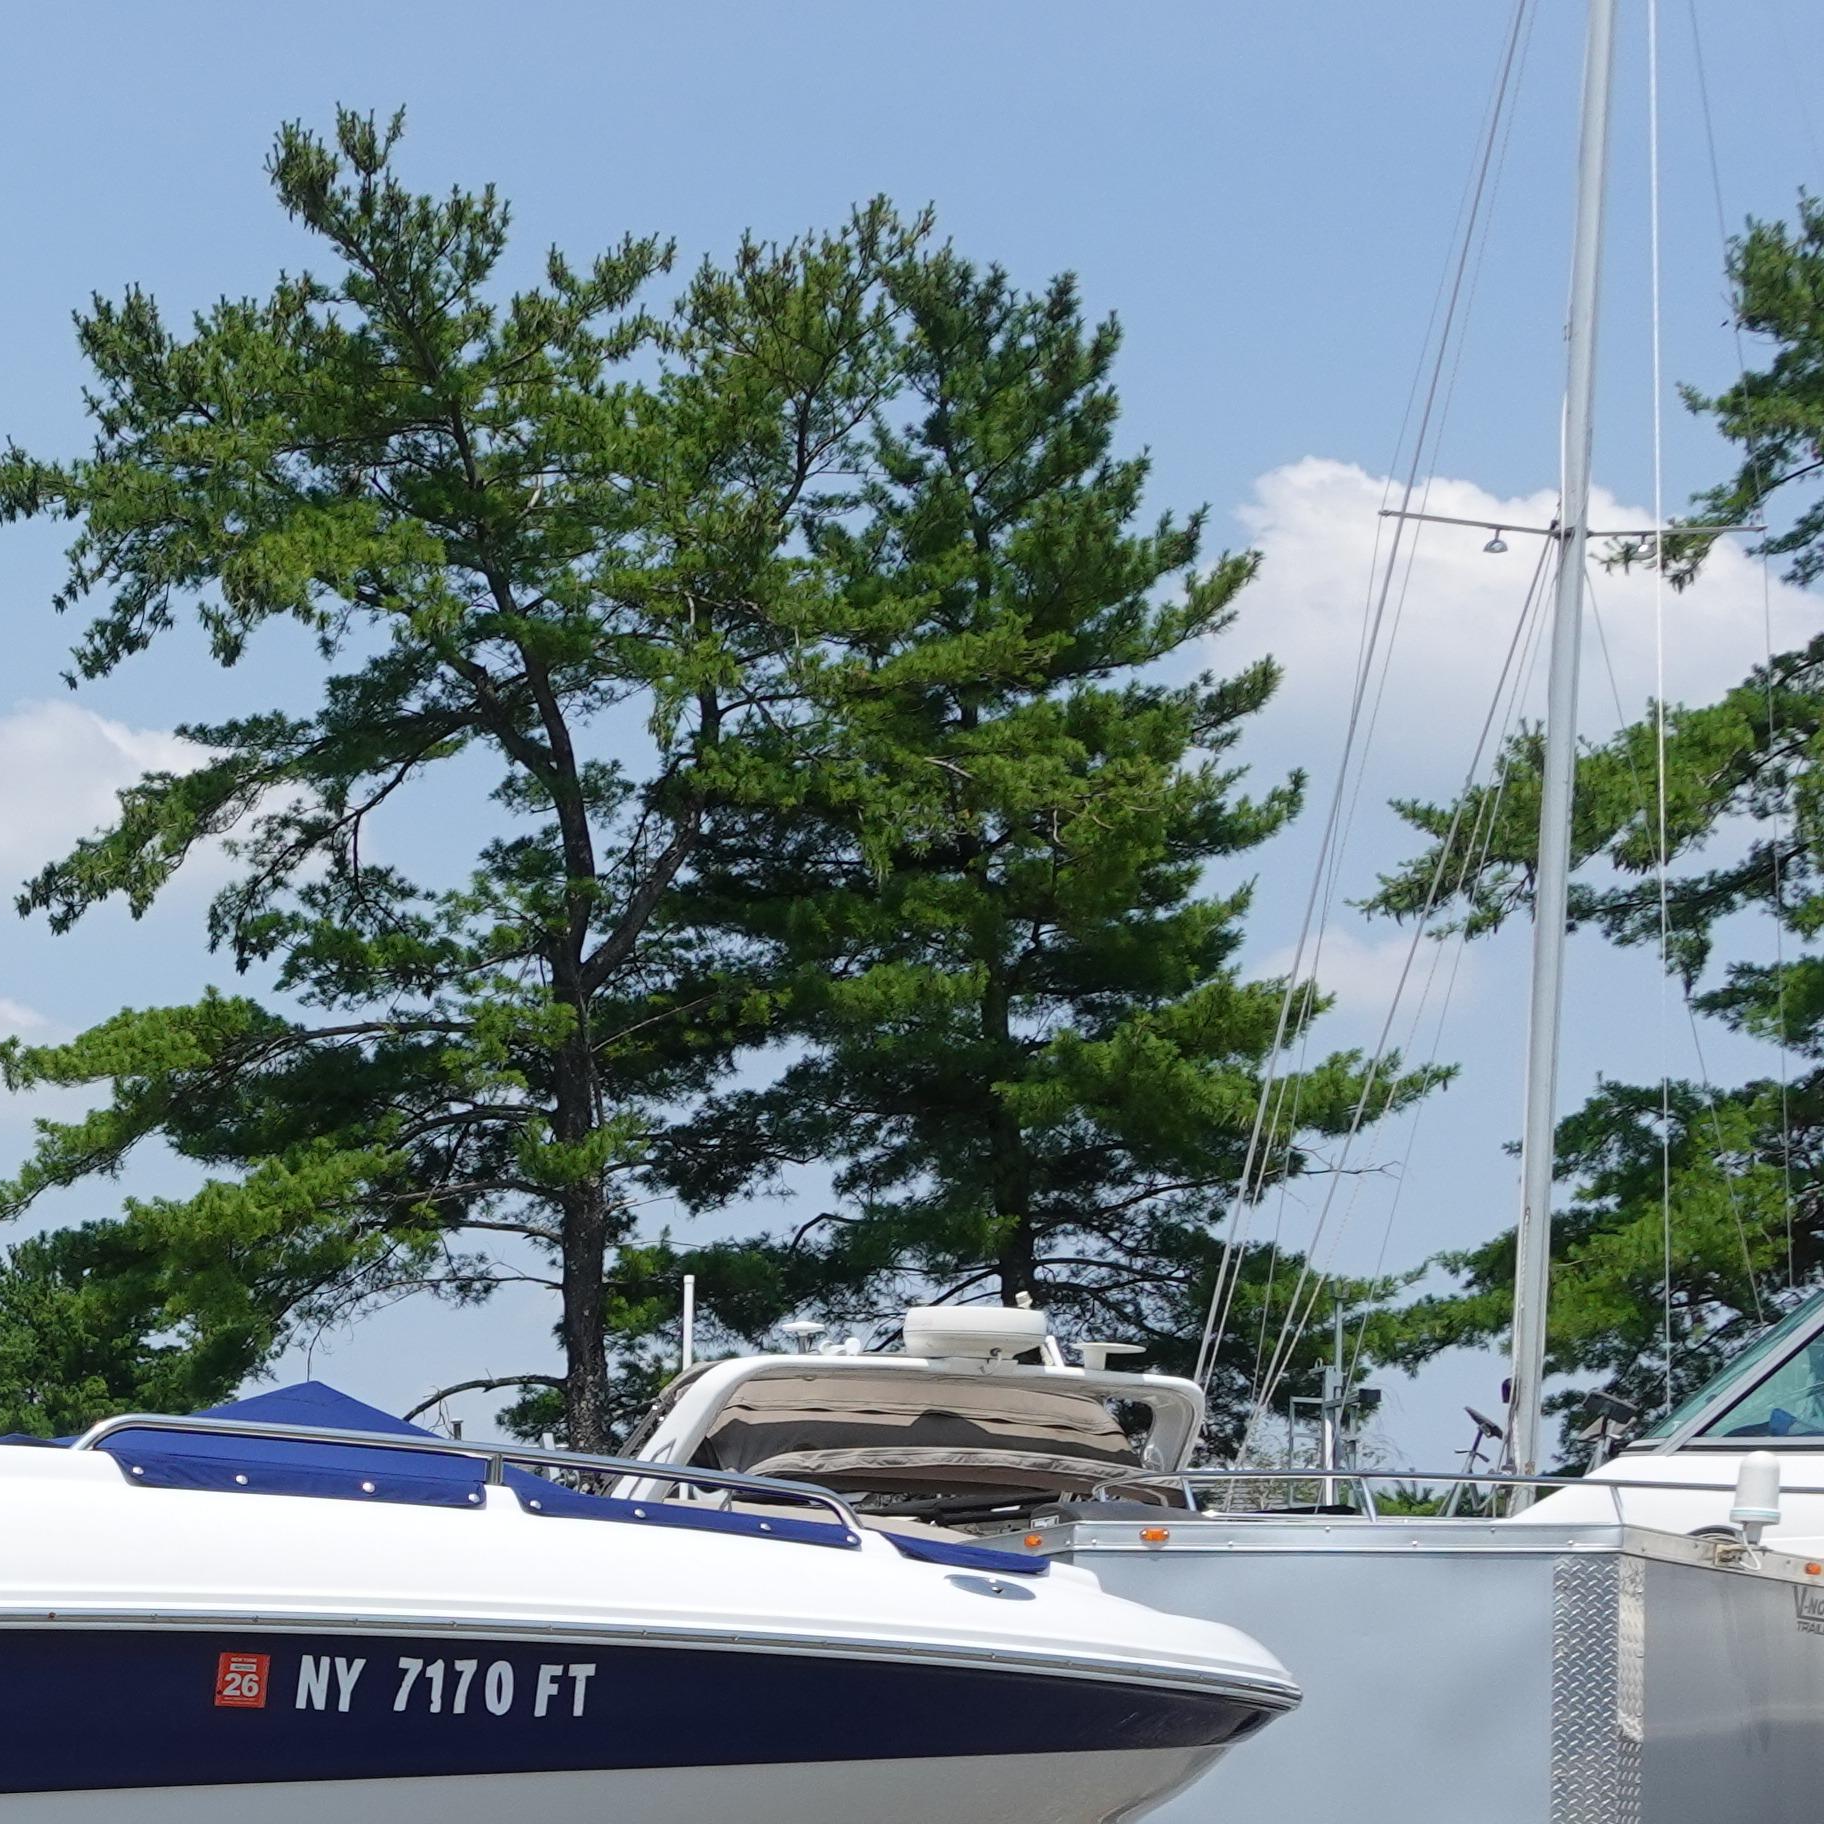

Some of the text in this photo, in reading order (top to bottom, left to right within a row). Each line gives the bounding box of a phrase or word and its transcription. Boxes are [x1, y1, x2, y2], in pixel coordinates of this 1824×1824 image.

[222, 1672, 260, 1698] 26
[295, 1654, 597, 1718] NY 7170 FT
